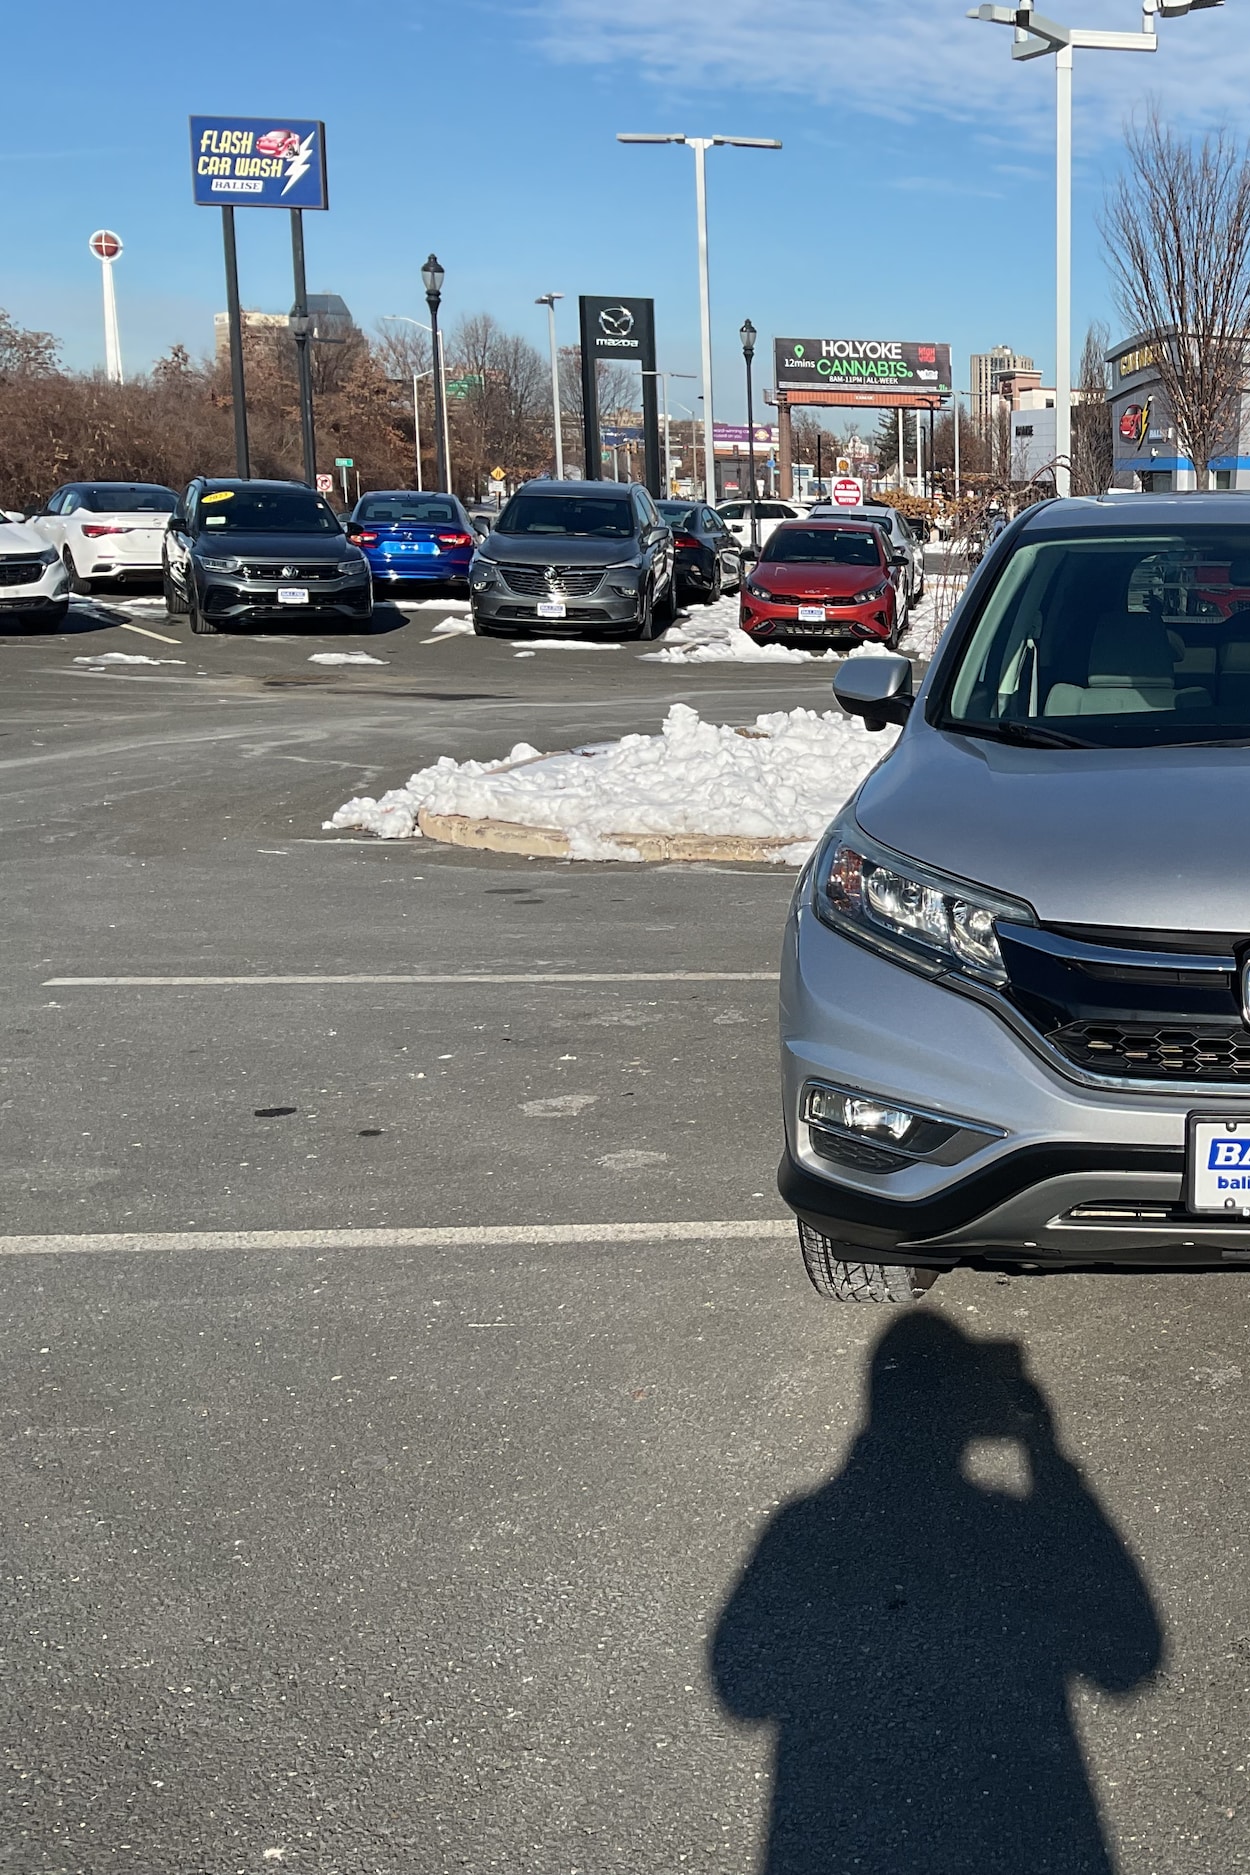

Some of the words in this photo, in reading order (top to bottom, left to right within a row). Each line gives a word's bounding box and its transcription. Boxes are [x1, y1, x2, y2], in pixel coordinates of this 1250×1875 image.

[200, 130, 253, 154] FLASH
[197, 156, 232, 175] CAR
[234, 157, 283, 177] WASH
[214, 181, 260, 190] BALISE
[596, 338, 639, 347] mazda
[822, 340, 902, 359] HOLYOKE
[784, 358, 815, 368] 12mins
